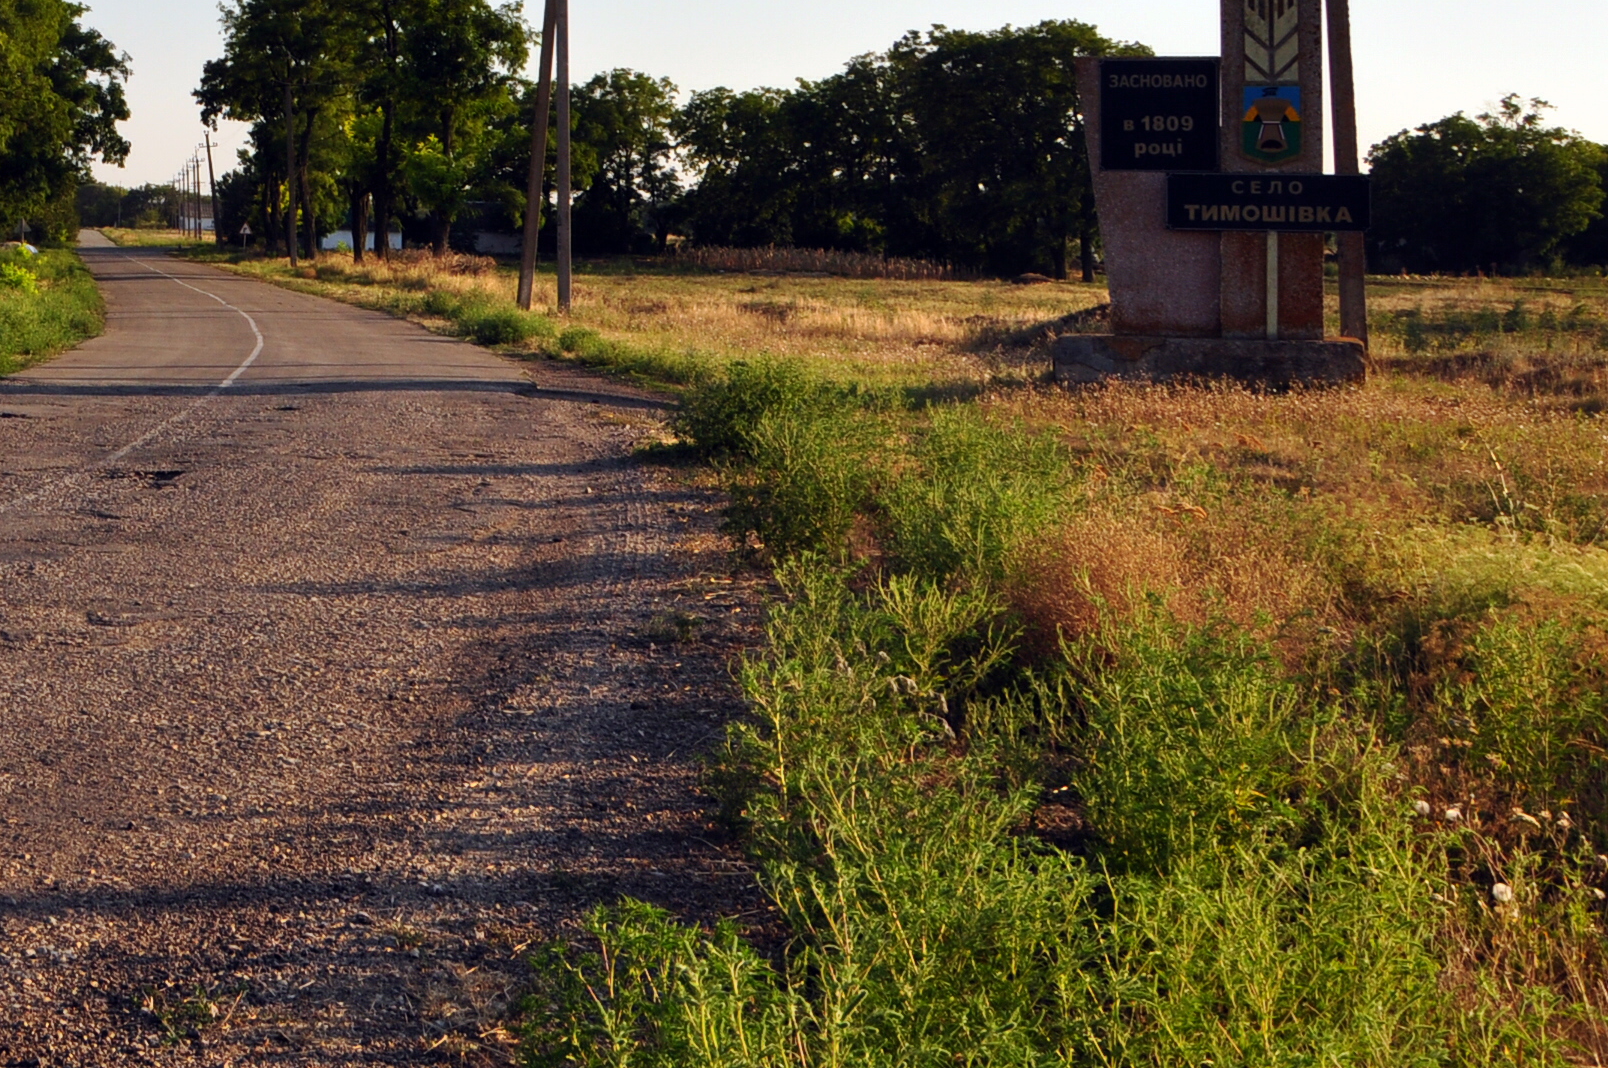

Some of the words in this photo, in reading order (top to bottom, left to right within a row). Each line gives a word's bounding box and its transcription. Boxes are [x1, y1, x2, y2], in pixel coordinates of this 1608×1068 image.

[1108, 74, 1208, 88] ЗАСНОВАНО
[1141, 115, 1194, 131] 1809
[1134, 138, 1182, 158] році
[1231, 180, 1303, 195] СЕЛО
[1184, 204, 1353, 223] ТИМОШІВКА
